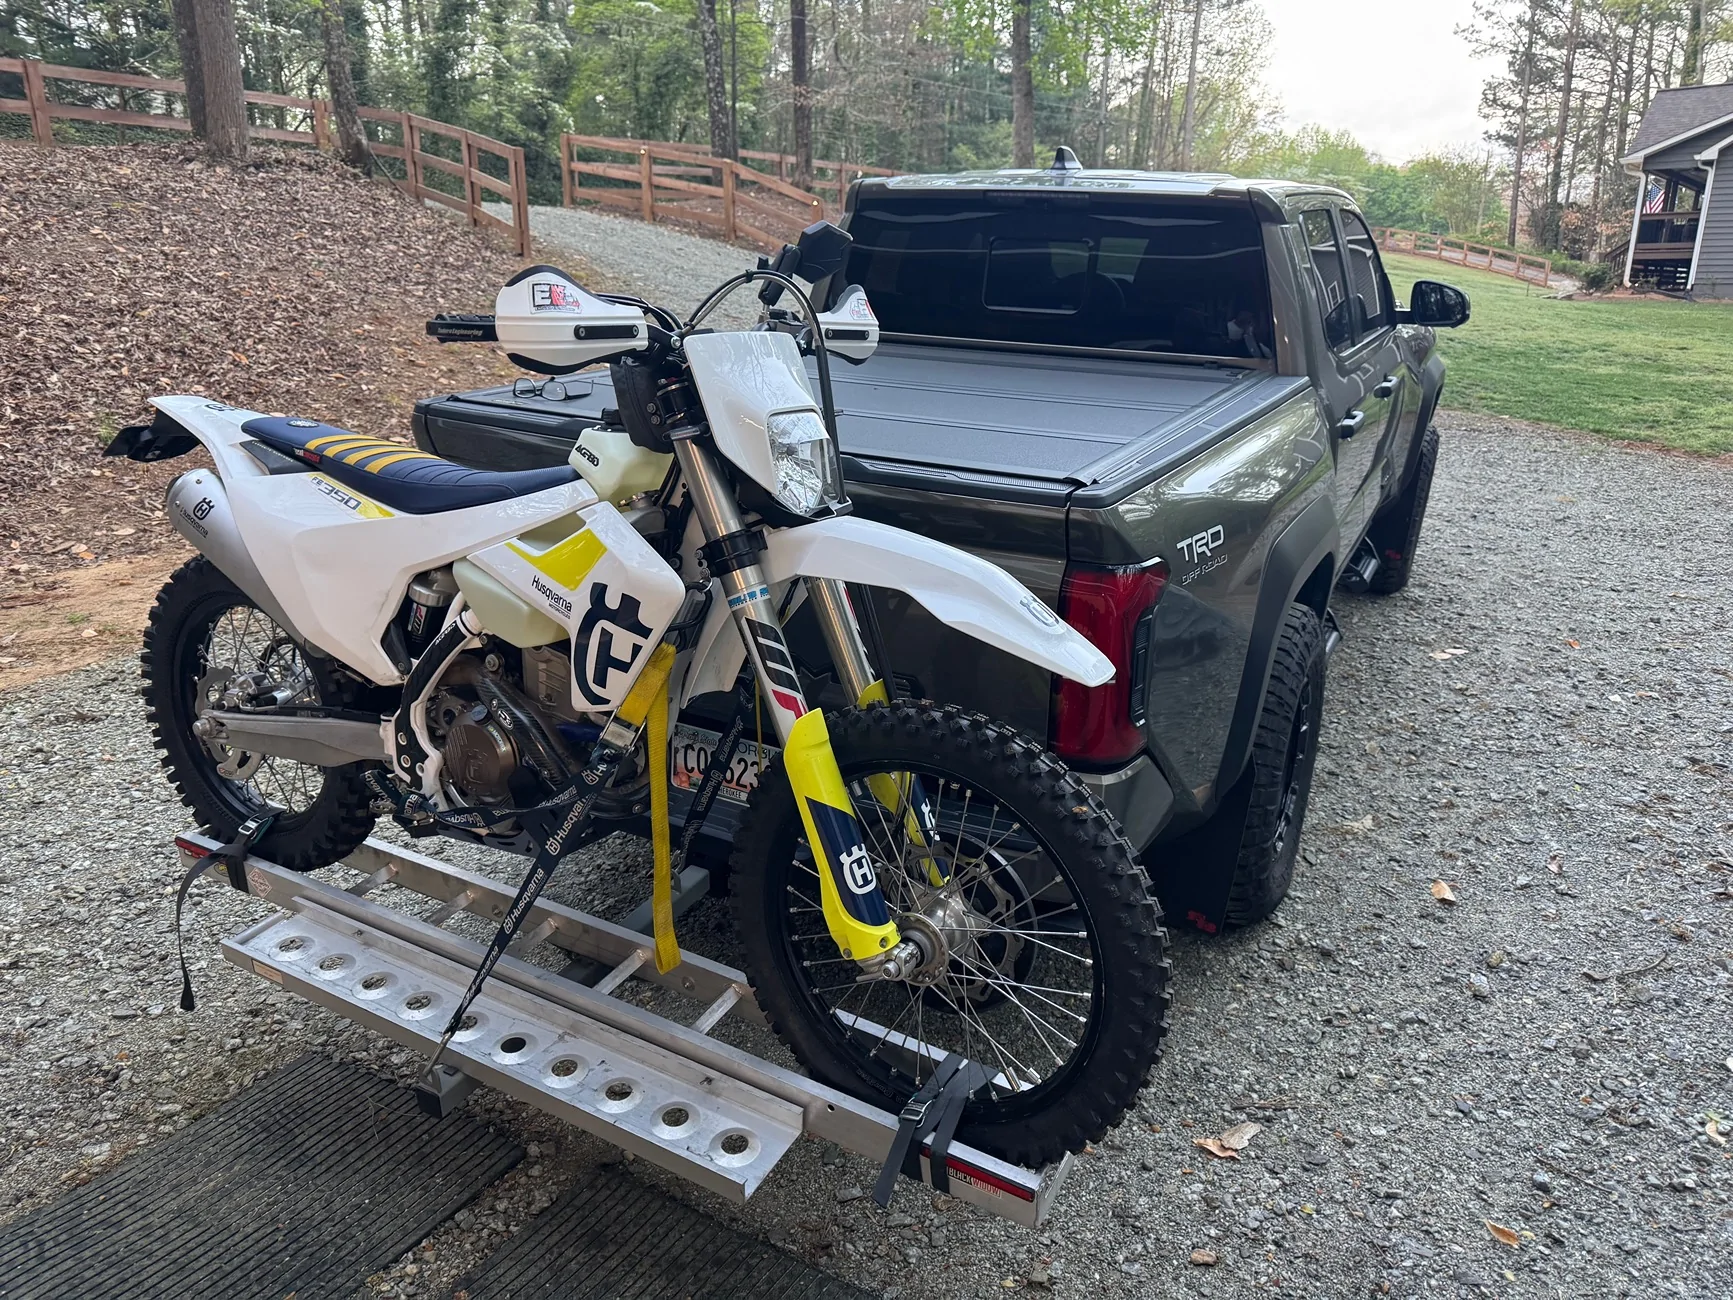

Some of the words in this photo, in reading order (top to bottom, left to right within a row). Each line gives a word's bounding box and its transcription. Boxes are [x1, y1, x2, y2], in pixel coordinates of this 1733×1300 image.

[317, 482, 362, 511] 350
[1176, 524, 1224, 563] TRD
[1182, 568, 1201, 586] OFF
[1201, 554, 1228, 575] ROAD
[531, 575, 572, 612] Husqvarna
[511, 867, 545, 923] Husqvarna
[948, 1167, 972, 1184] BLACK
